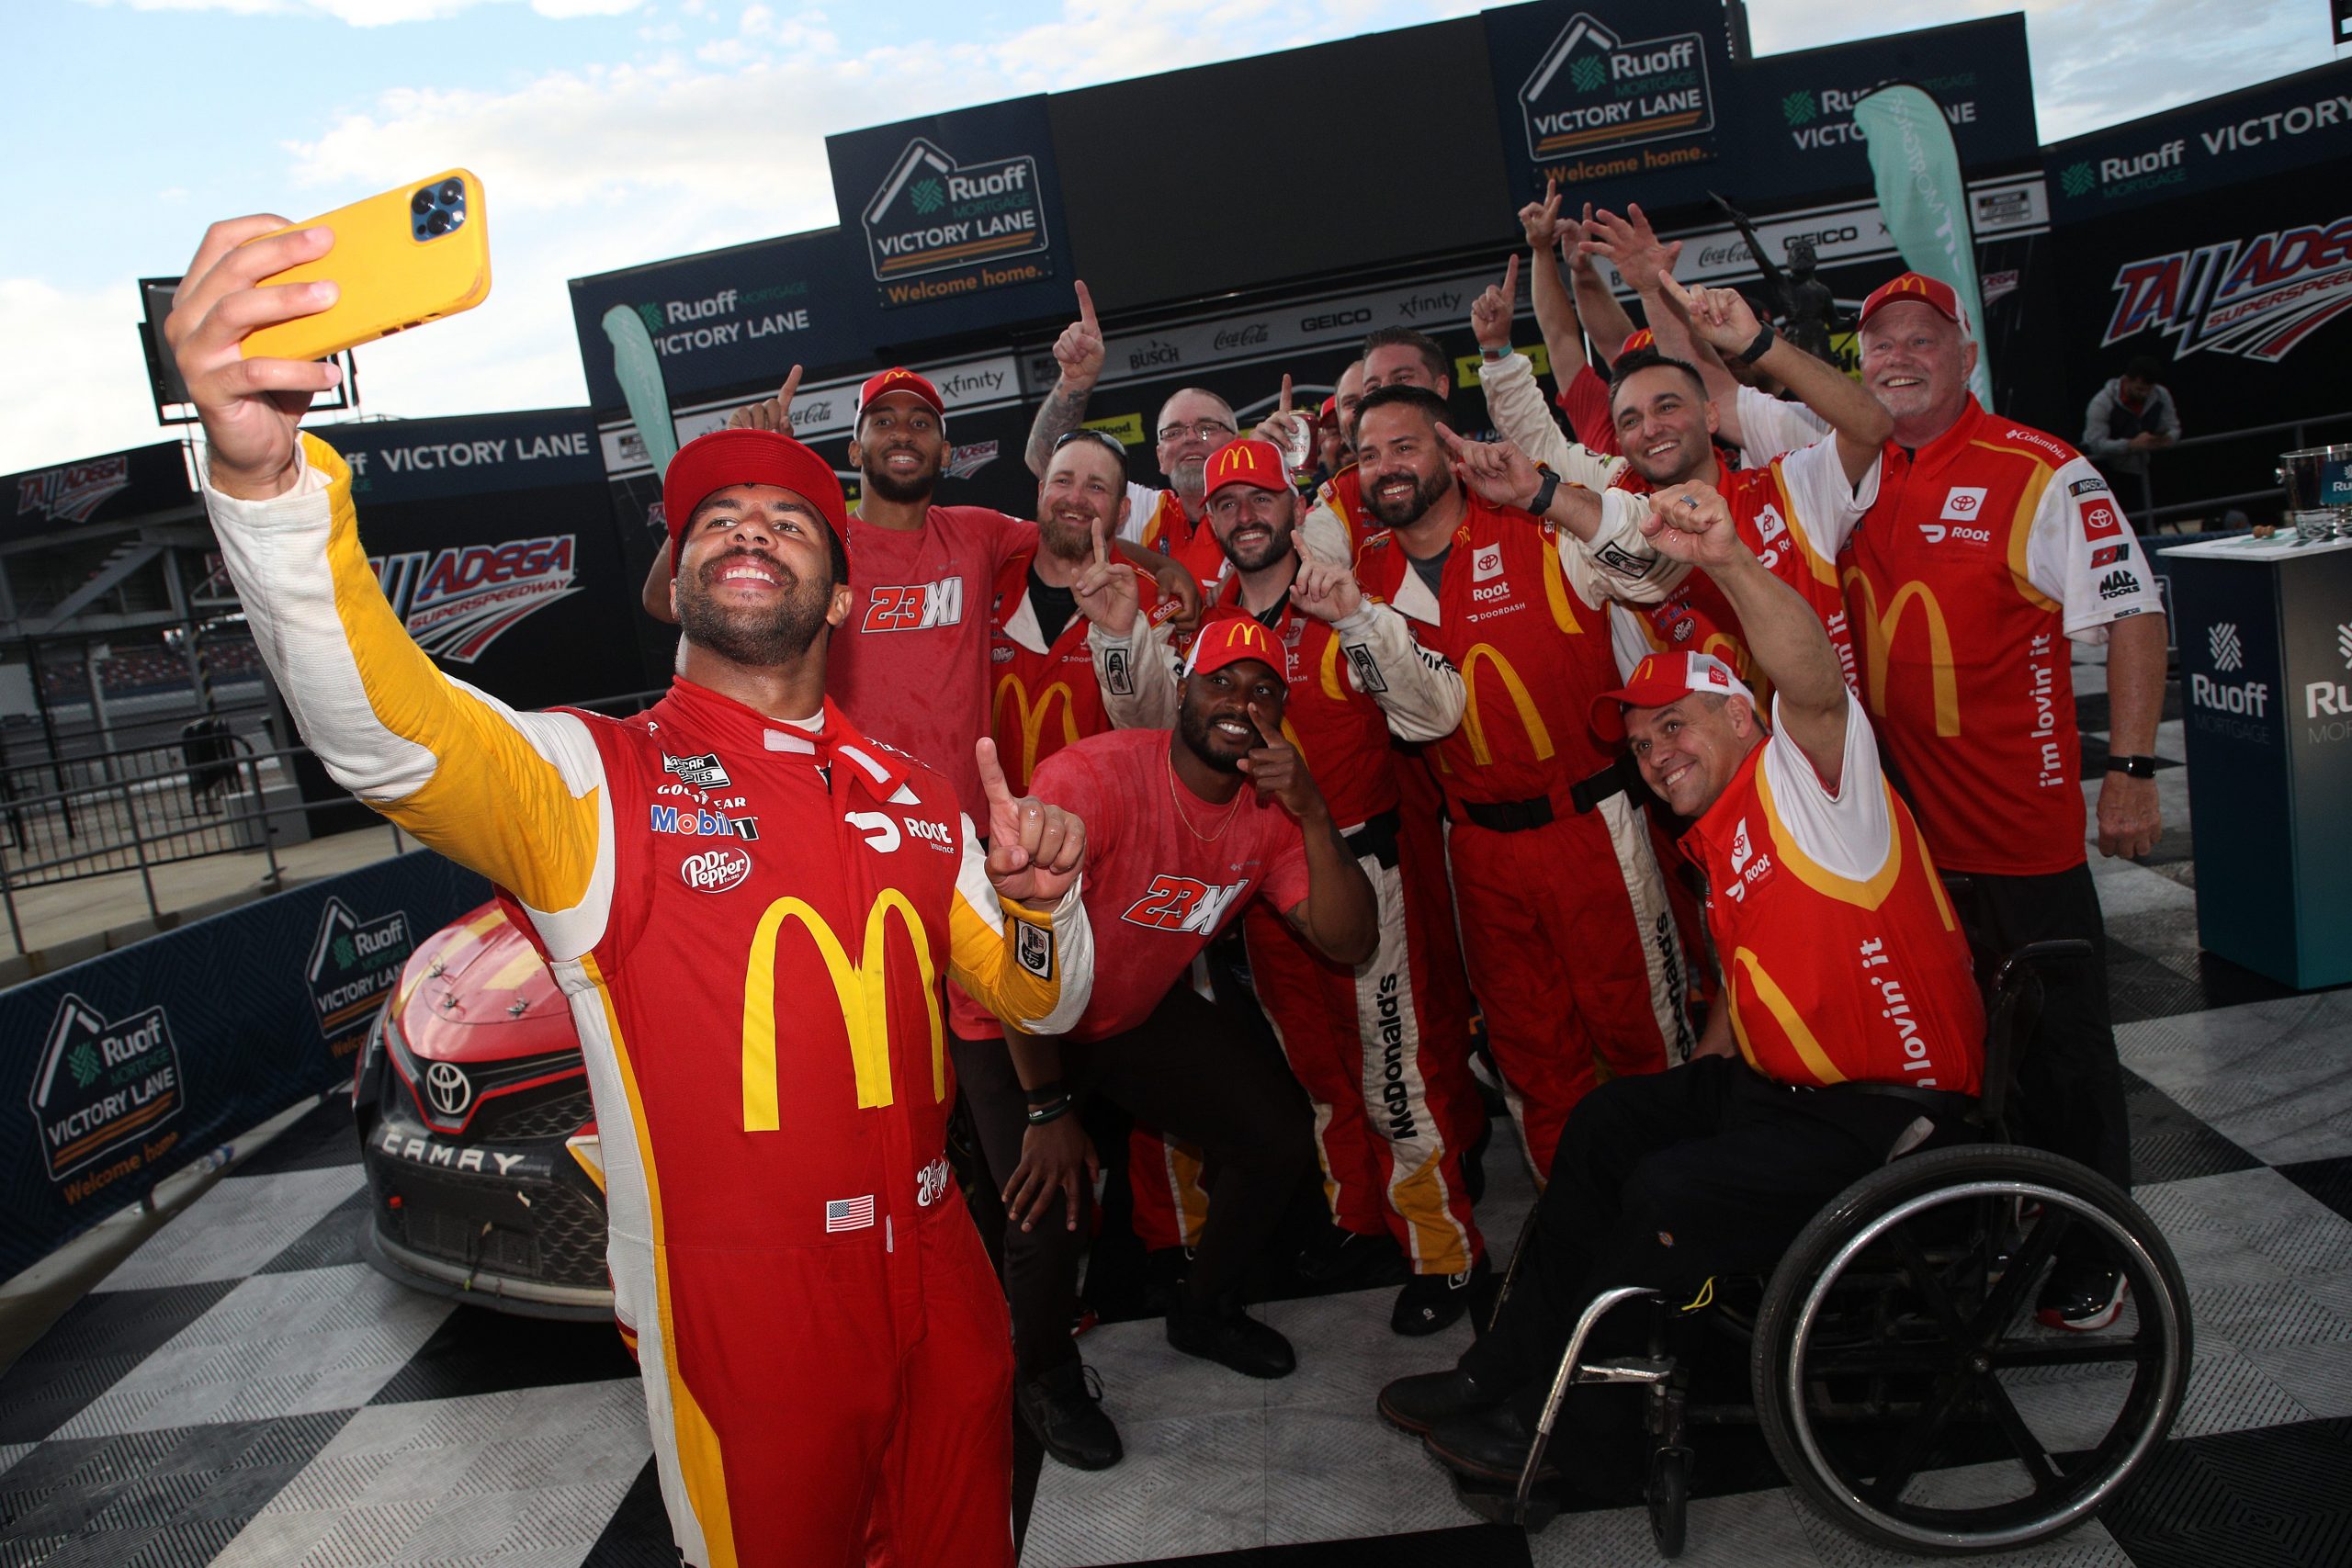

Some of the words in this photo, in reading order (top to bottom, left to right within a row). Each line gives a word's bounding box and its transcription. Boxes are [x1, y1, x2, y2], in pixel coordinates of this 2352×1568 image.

[1611, 41, 1694, 80] Ruoff
[1615, 71, 1698, 96] MORTGAGE
[1534, 100, 1633, 135] VICTORY
[1640, 88, 1702, 118] LANE
[1793, 122, 1868, 151] VICTO
[1544, 155, 1639, 184] Welcome
[2100, 140, 2185, 184] Ruoff
[948, 164, 1027, 202] Ruoff
[2103, 167, 2187, 198] MORTGAGE
[953, 192, 1031, 219] MORTGAGE
[877, 221, 970, 256] VICTORY
[977, 209, 1035, 238] LANE
[666, 288, 738, 324] Ruoff
[740, 282, 808, 304] MORTGAGE
[888, 276, 978, 304] Welcome
[747, 309, 810, 339] LANE
[1129, 346, 1181, 369] BUSCH
[1300, 309, 1372, 333] GEICO
[1398, 291, 1463, 318] xfinity
[942, 369, 1005, 399] xfinity
[381, 439, 507, 473] VICTORY
[515, 433, 590, 461] LANE
[2017, 431, 2066, 459] Columbia
[1951, 526, 1991, 542] Root
[411, 577, 570, 631] SUPERSPEEDWAY
[861, 576, 963, 634] 23XI
[1473, 581, 1510, 602] Root
[2100, 584, 2141, 600] TOOLS
[1480, 602, 1526, 621] DOORDASH
[1827, 610, 1848, 637] it
[2030, 633, 2051, 656] it
[2029, 663, 2055, 739] lovin'
[2190, 671, 2268, 719] Ruoff
[2194, 712, 2271, 746] MORTGAGE
[2039, 741, 2064, 787] i'm
[650, 805, 734, 837] Mobil
[903, 817, 953, 844] Root
[690, 854, 746, 889] Pepper
[705, 851, 729, 870] Dr
[1745, 852, 1771, 885] Root
[354, 919, 405, 957] Ruoff
[1860, 936, 1888, 970] it
[317, 975, 376, 1014] VICTORY
[1657, 911, 1691, 1063] cDonald's
[101, 1015, 161, 1068] Ruoff
[1871, 976, 1932, 1074] lovin'
[110, 1046, 170, 1088] MORTGAGE
[1378, 973, 1418, 1141] McDonald's
[47, 1089, 129, 1148] VICTORY
[130, 1066, 176, 1113] LANE
[62, 1152, 141, 1207] Welcome
